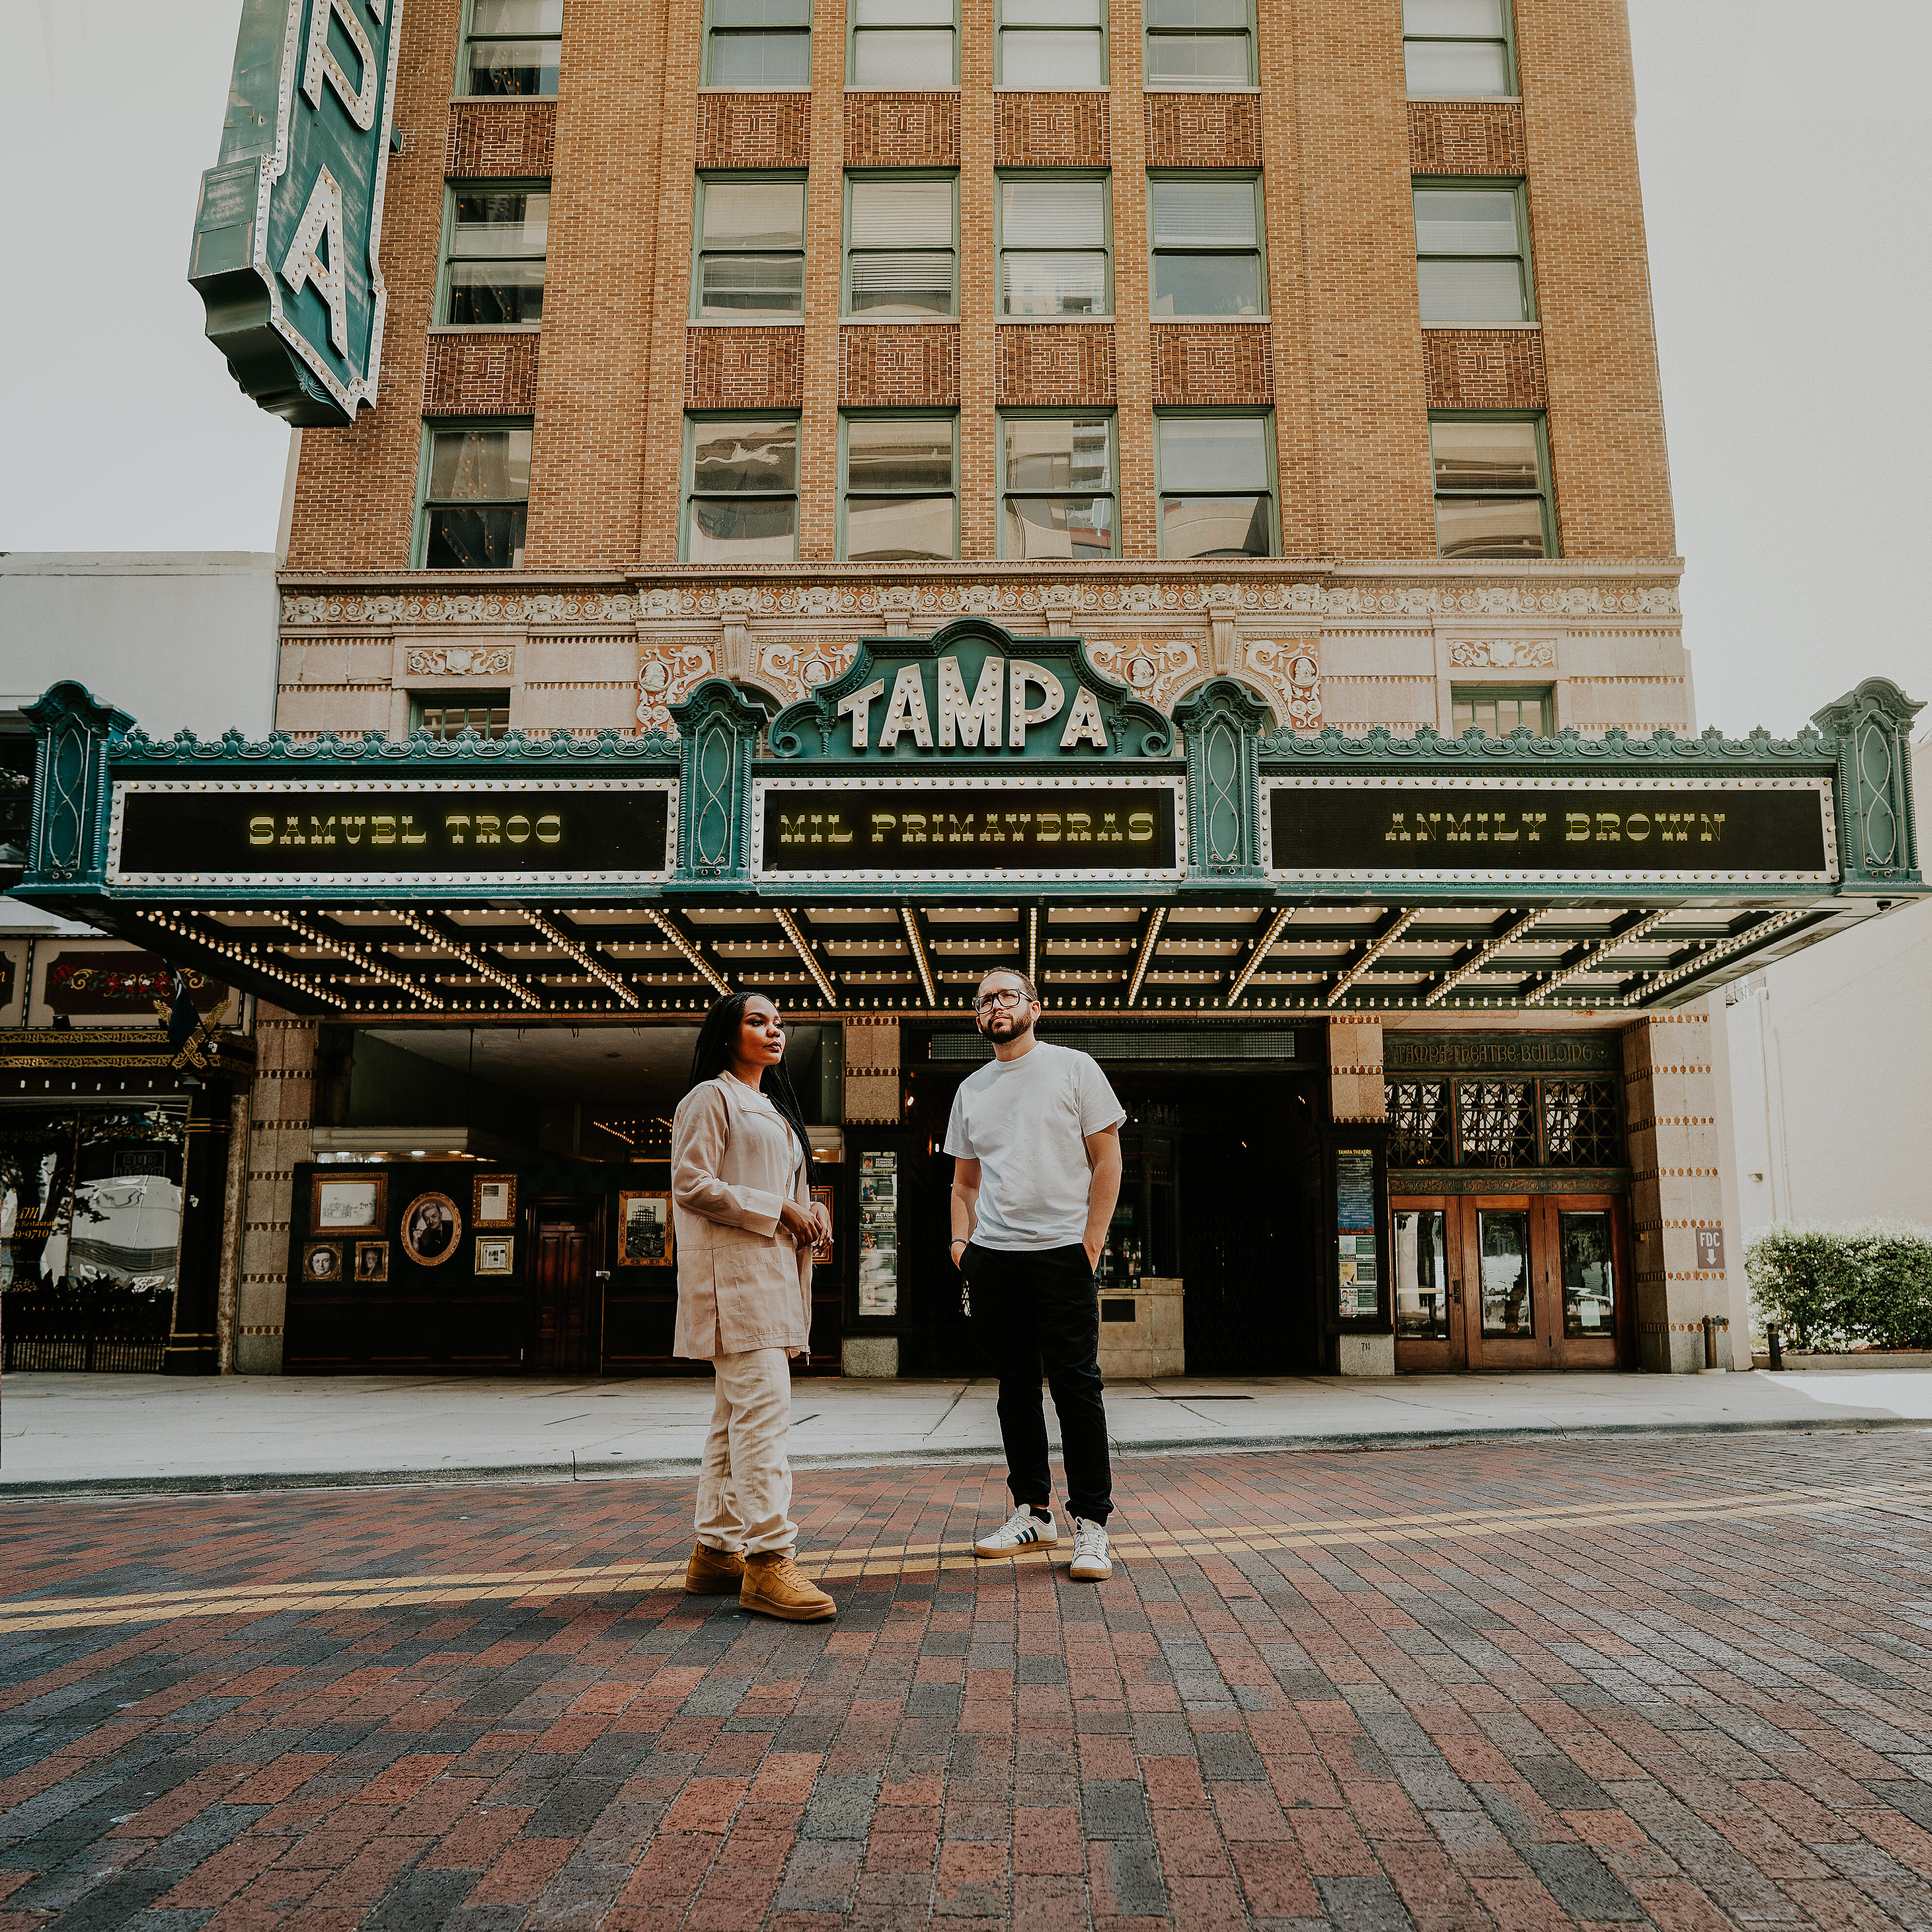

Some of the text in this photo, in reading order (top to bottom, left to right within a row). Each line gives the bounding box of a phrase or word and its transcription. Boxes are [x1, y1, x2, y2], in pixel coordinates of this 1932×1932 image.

[838, 656, 1108, 747] TAMPA
[249, 815, 560, 844] SAMUEL TROC
[780, 813, 1154, 842] MIL PRIMAVERAS
[1385, 813, 1725, 841] ANMILY BROWN
[1395, 1044, 1446, 1064] TAMPA
[1520, 1044, 1592, 1062] BUILDING
[1491, 1155, 1514, 1169] 707
[1700, 1232, 1721, 1247] FDC
